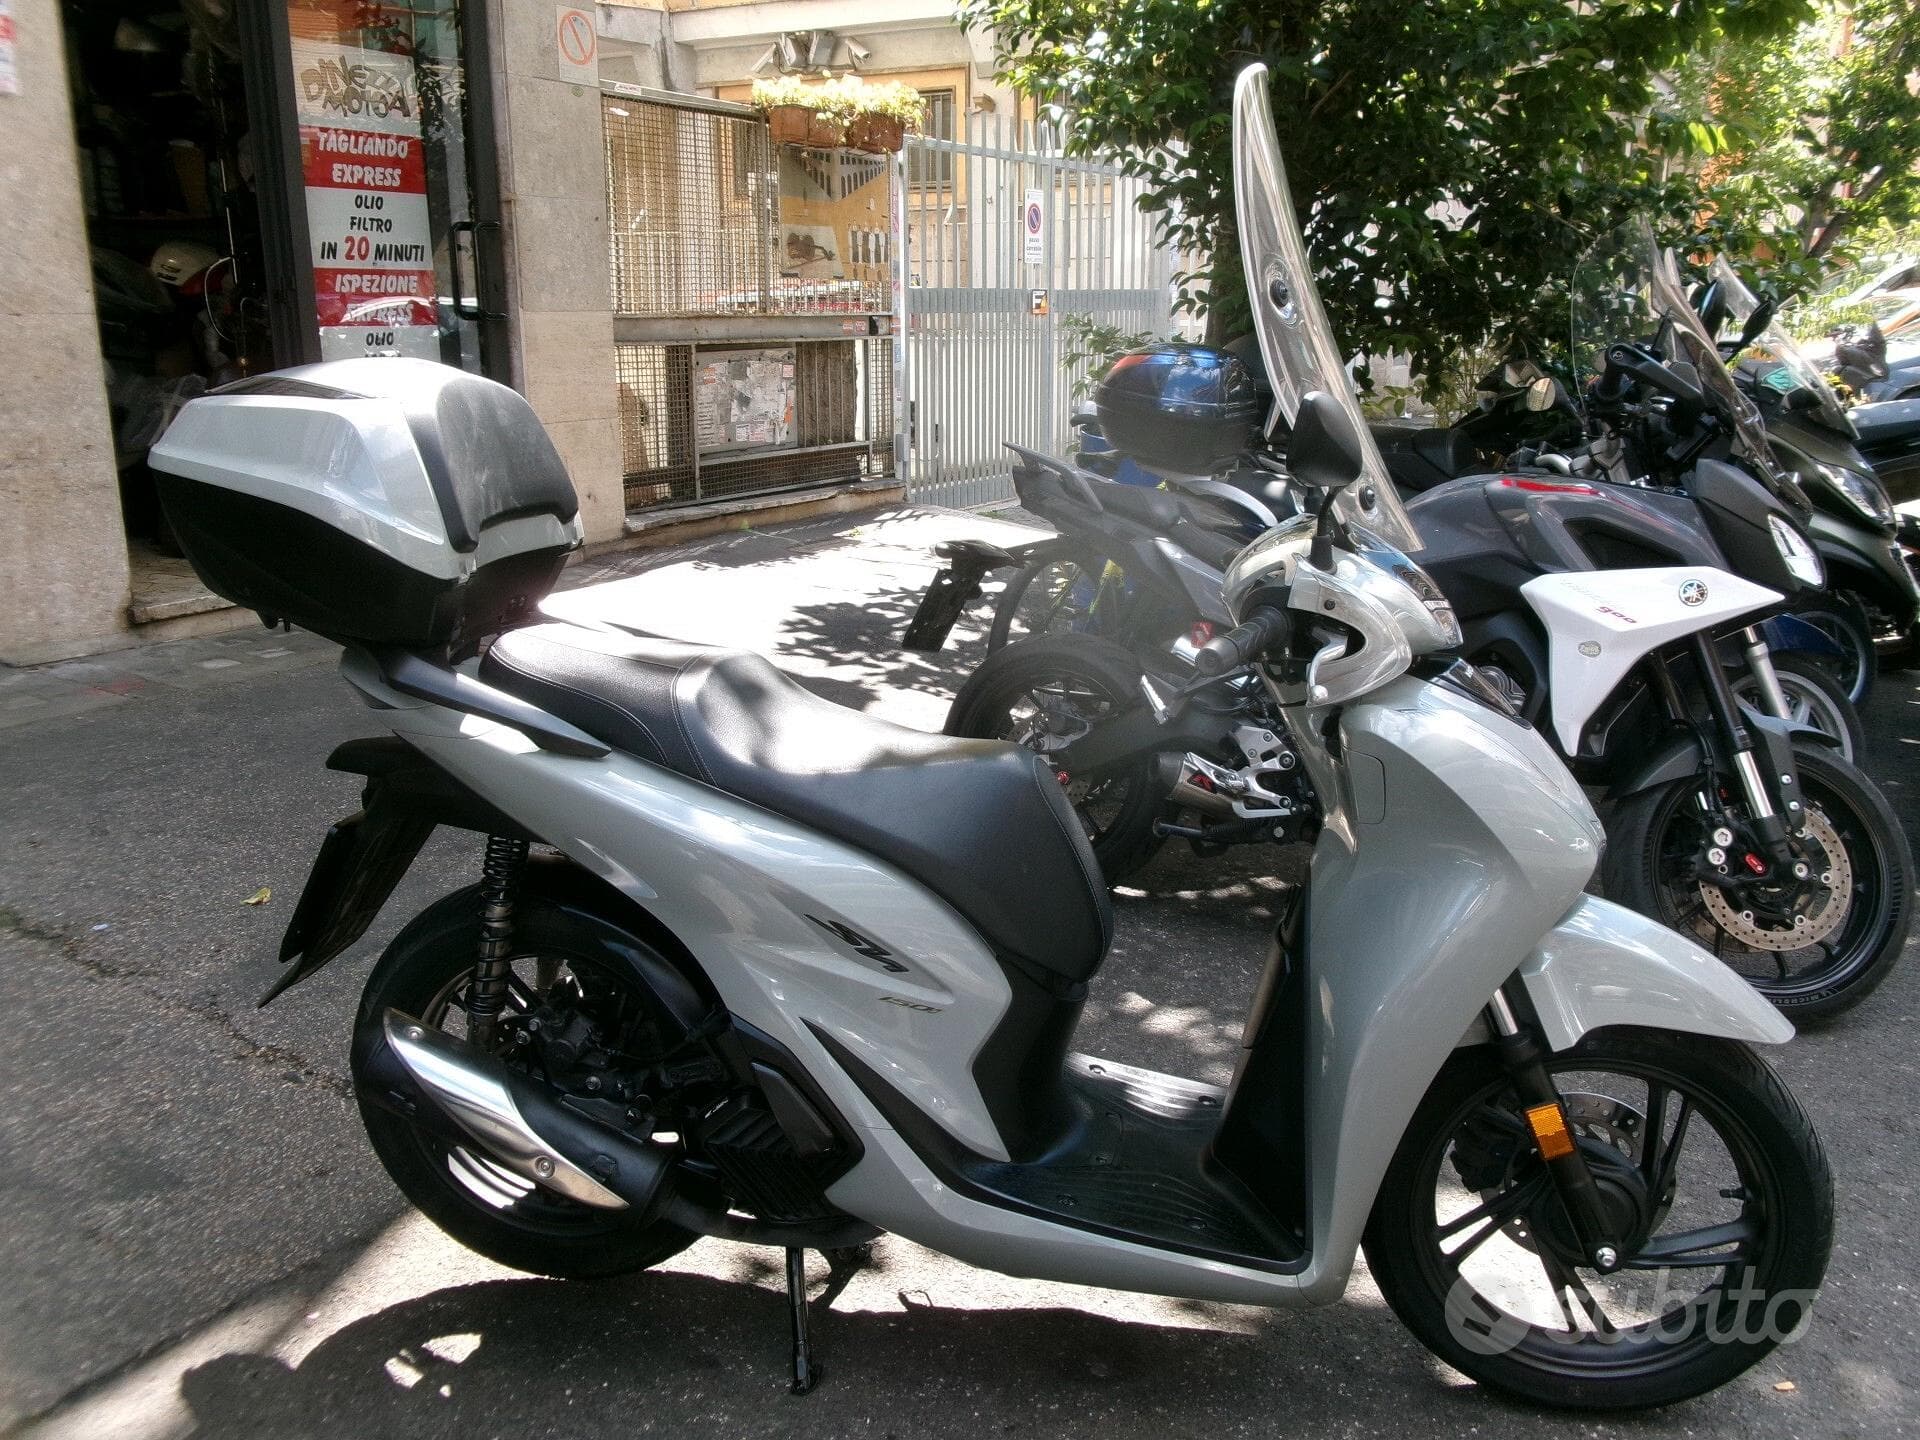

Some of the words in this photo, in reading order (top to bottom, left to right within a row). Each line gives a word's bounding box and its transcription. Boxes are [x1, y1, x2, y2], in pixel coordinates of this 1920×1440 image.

[317, 131, 408, 159] TAGLIANDO
[332, 163, 402, 187] EXPRESS
[354, 194, 384, 210] OLIO
[350, 216, 393, 233] FILTRO
[320, 241, 338, 260] IN
[344, 235, 370, 261] 20
[374, 243, 425, 262] MINUTI
[335, 273, 418, 294] ISPEZIONE
[366, 331, 395, 347] OLIO
